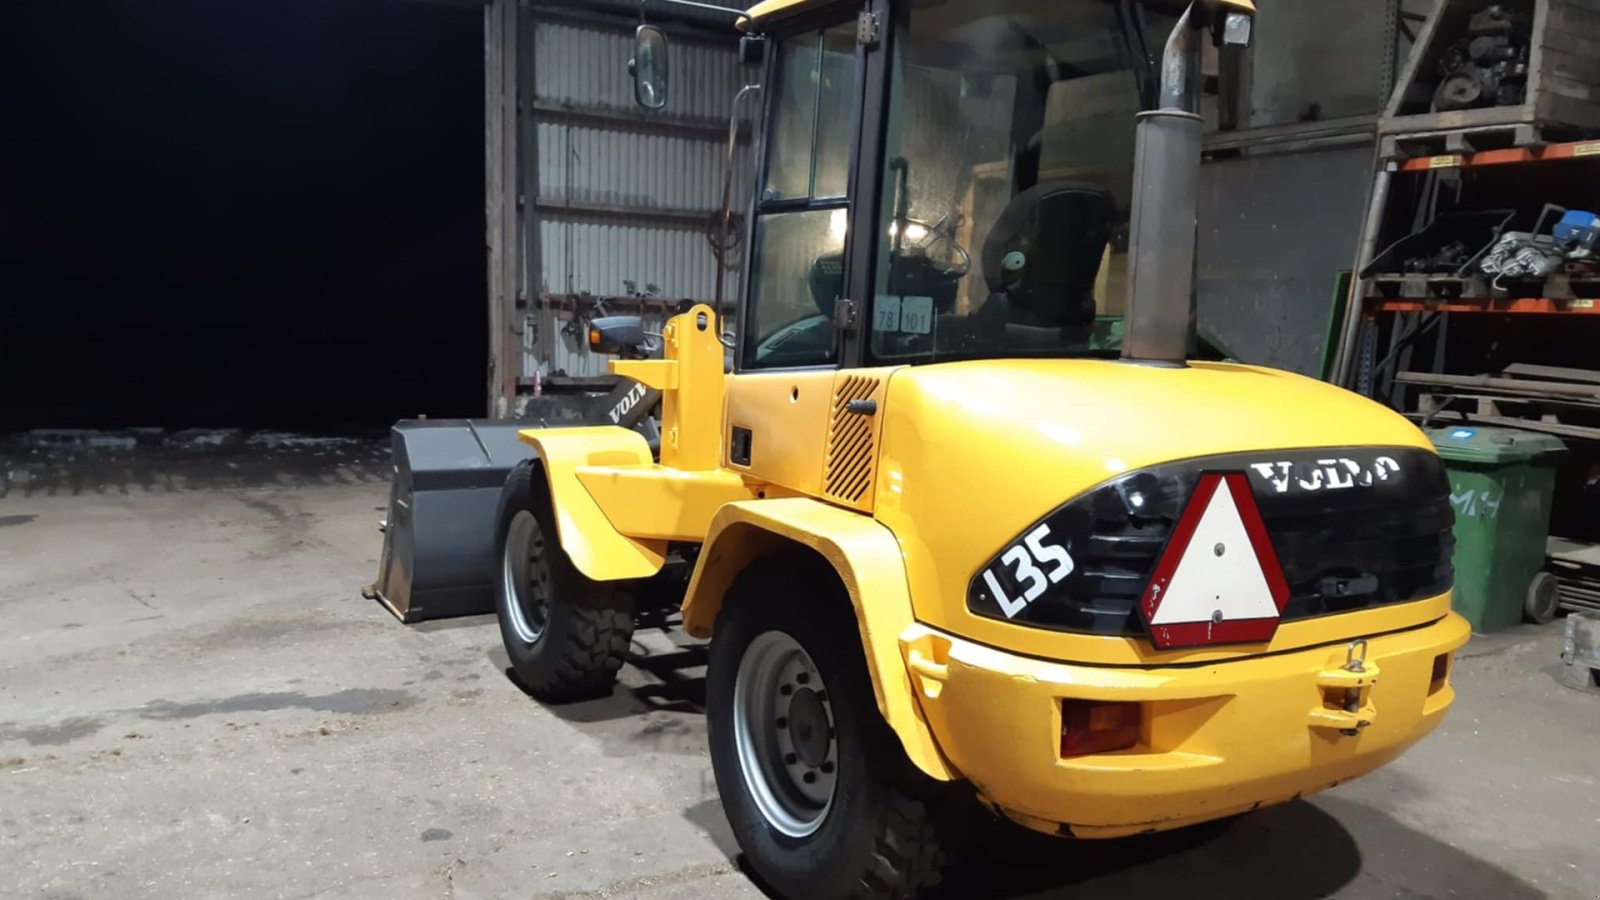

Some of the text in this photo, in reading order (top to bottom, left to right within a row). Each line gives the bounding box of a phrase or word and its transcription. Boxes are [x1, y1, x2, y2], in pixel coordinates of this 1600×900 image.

[879, 310, 894, 329] 78
[905, 311, 927, 331] 101
[608, 382, 647, 424] VOLV
[982, 523, 1074, 619] L35
